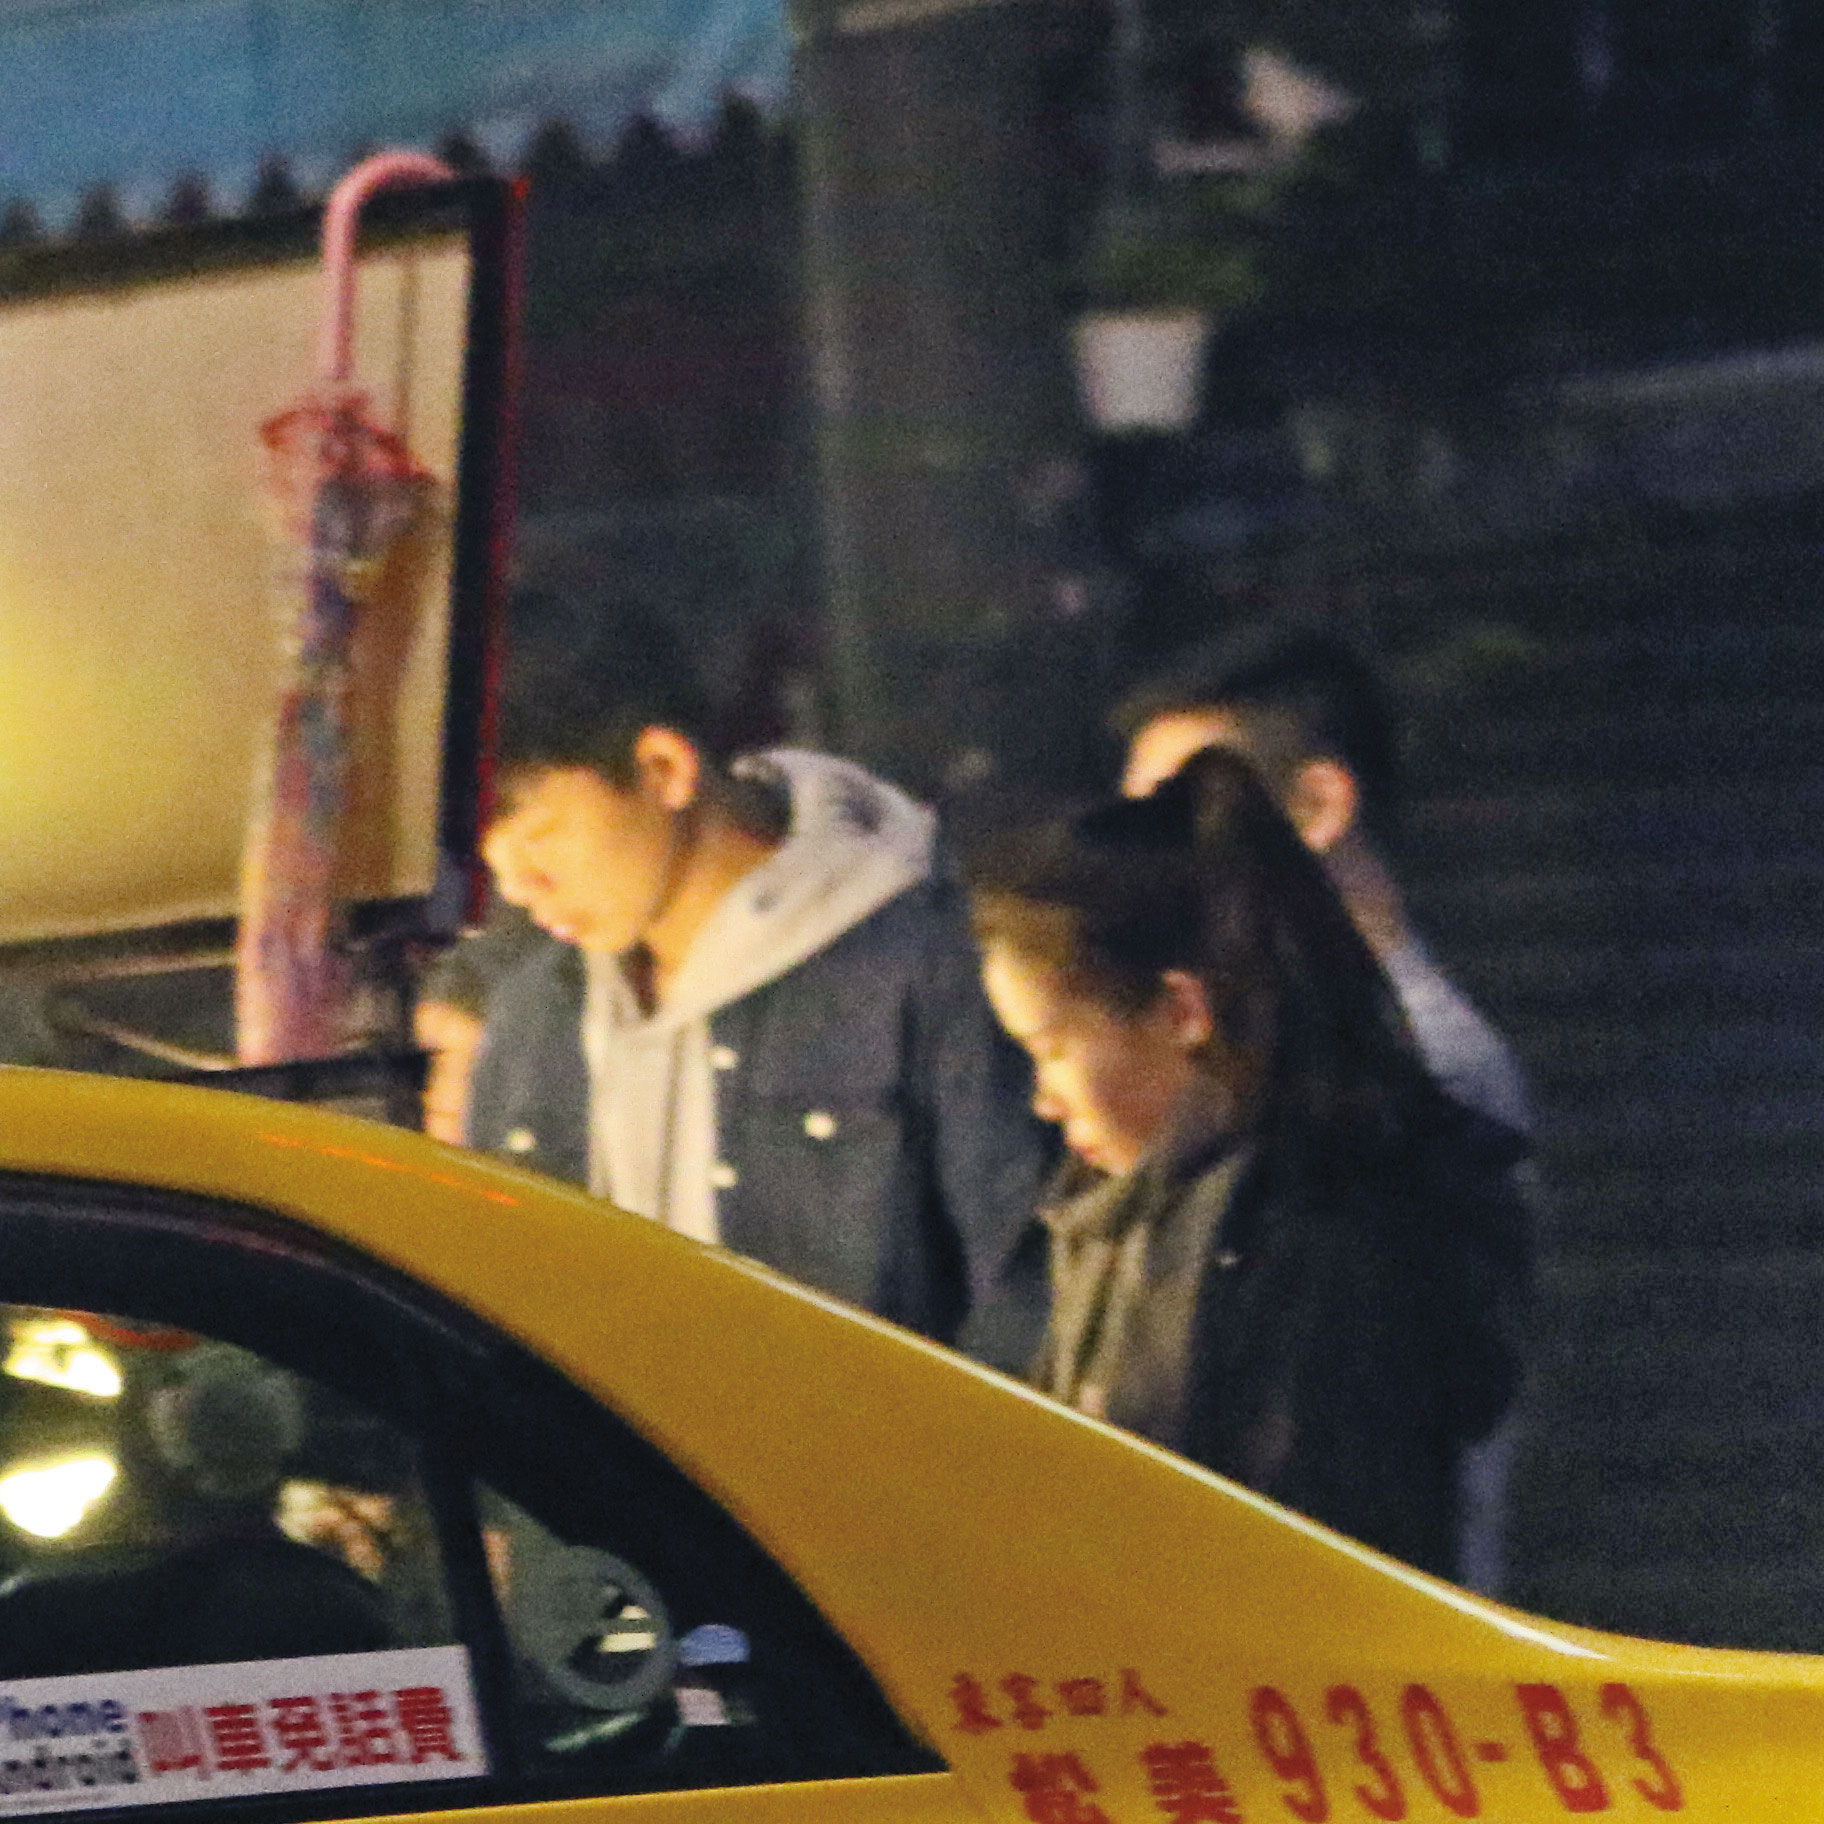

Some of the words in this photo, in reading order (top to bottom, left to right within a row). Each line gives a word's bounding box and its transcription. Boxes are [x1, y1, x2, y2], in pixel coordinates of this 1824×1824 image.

[0, 1737, 141, 1794] ndroid
[137, 1685, 463, 1780] 叫車免話費
[1248, 1682, 1686, 1824] 930-B3
